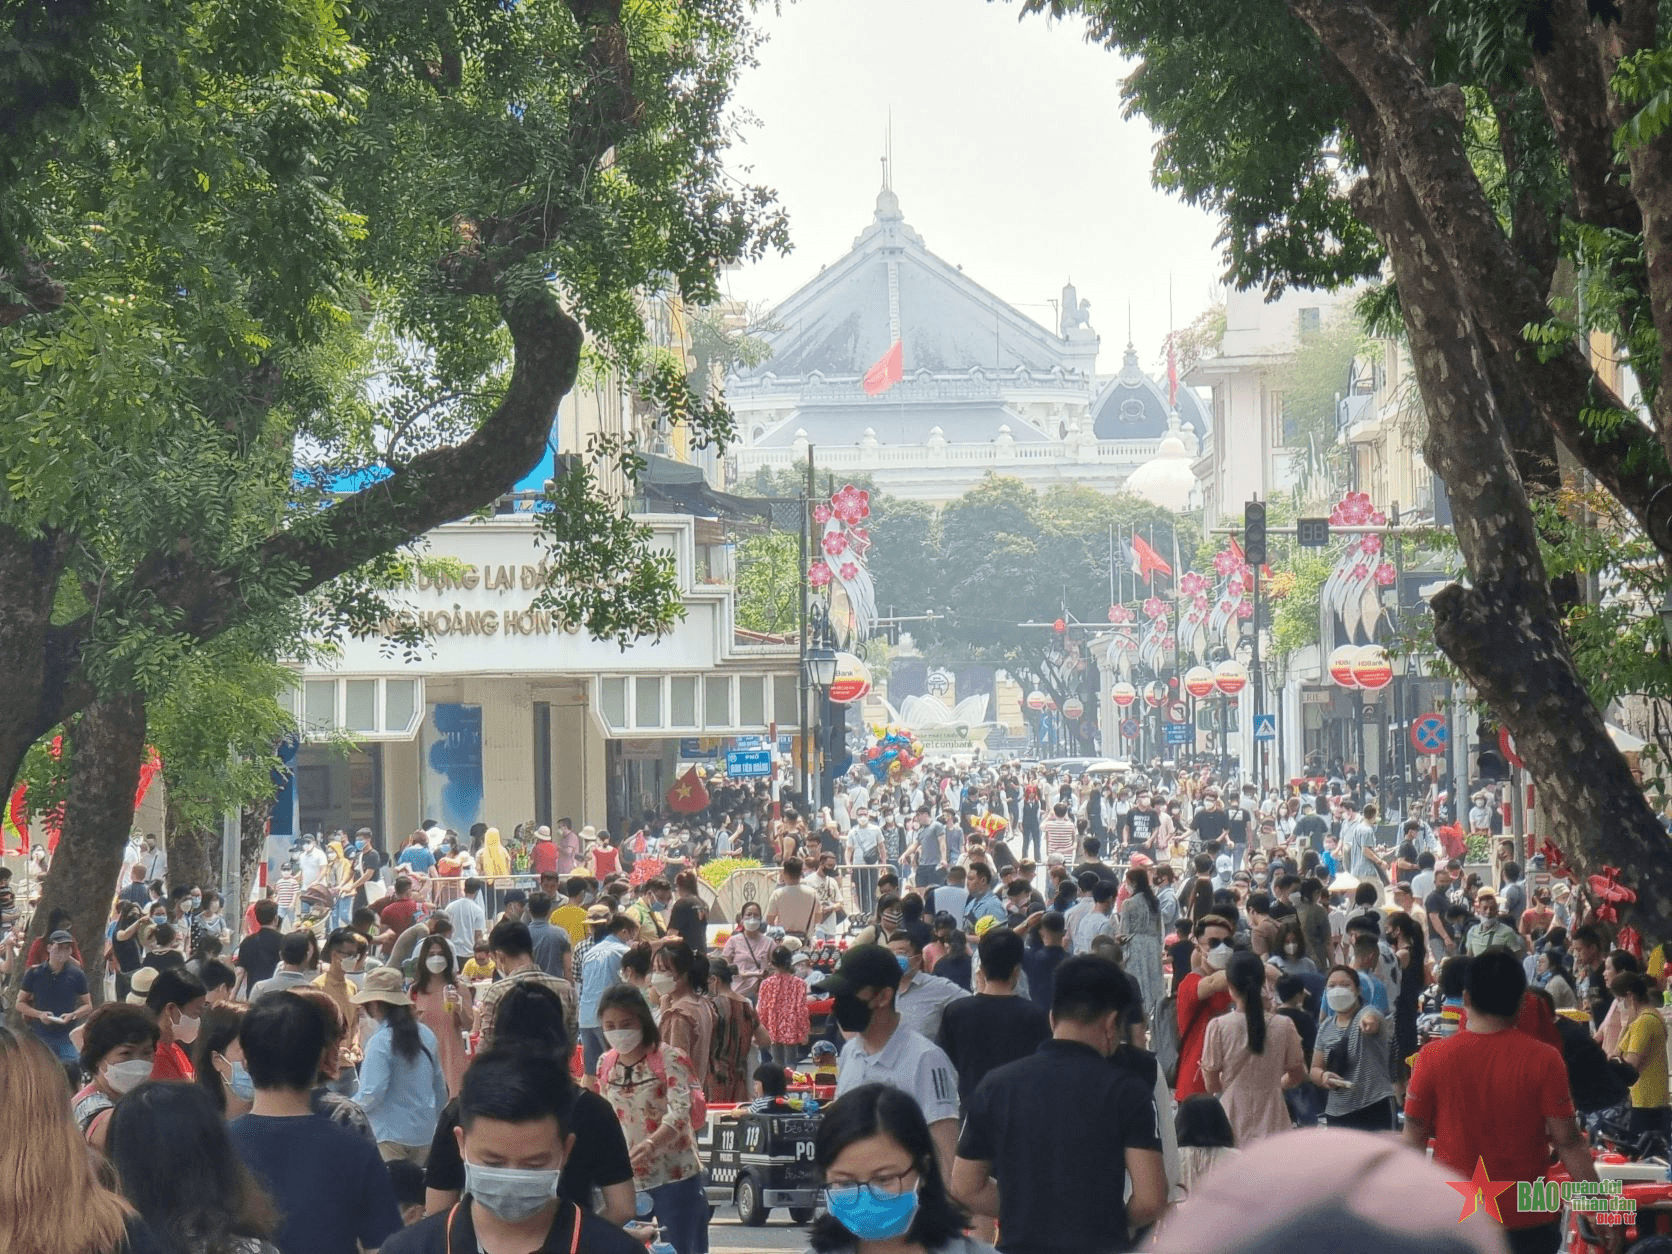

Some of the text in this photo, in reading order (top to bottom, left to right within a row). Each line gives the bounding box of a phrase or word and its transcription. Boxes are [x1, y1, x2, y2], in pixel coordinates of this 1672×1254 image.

[484, 564, 516, 597] LẠI
[721, 1130, 735, 1150] 113
[745, 1126, 760, 1147] 113
